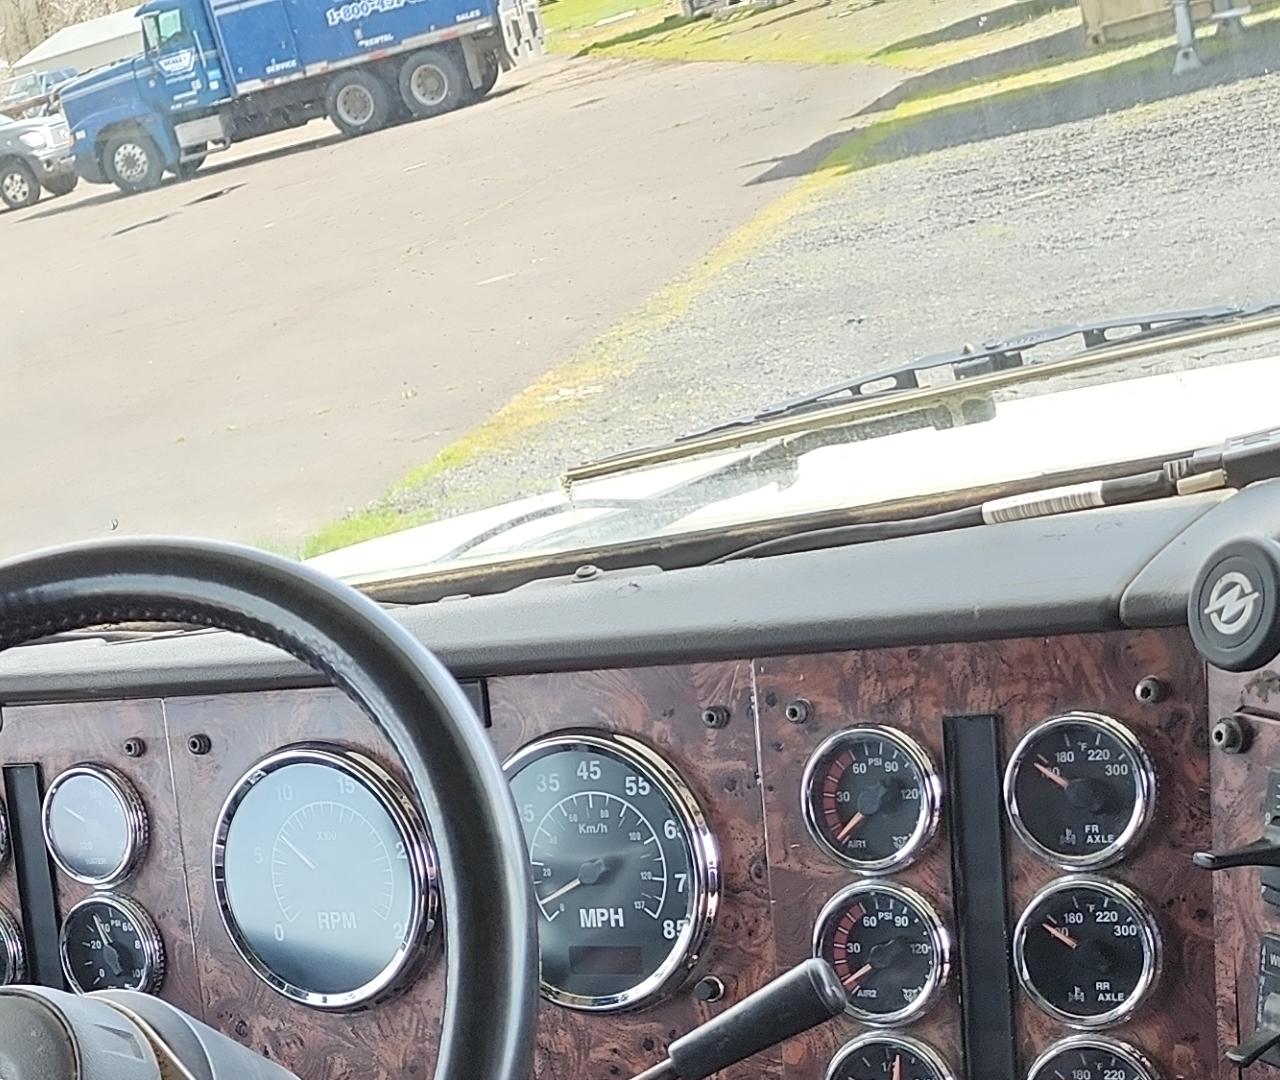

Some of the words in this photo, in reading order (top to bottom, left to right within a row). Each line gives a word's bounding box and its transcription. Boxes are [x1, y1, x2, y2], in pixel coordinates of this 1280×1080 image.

[265, 58, 297, 75] SERVICE
[1057, 751, 1074, 762] 180
[1088, 749, 1110, 761] 220
[576, 760, 602, 780] 45
[853, 763, 867, 774] 60
[868, 757, 883, 766] PSI
[884, 761, 898, 772] 90
[1105, 764, 1128, 776] 300
[336, 776, 355, 795] 15
[536, 773, 560, 792] 35
[625, 777, 651, 796] 55
[277, 784, 293, 801] 10
[836, 791, 850, 802] 30
[902, 788, 919, 800] 120
[578, 823, 608, 834] Km/h
[1084, 824, 1099, 833] FR
[628, 832, 641, 841] 100
[1086, 834, 1114, 843] AXLE
[253, 847, 263, 864] 5
[542, 867, 551, 877] 20
[640, 871, 652, 880] 120
[317, 912, 357, 929] RPM
[579, 908, 624, 928] MPH
[863, 916, 877, 927] 60
[878, 911, 893, 921] PSI
[895, 916, 908, 927] 90
[1064, 912, 1083, 924] 180
[1095, 911, 1118, 922] 220
[122, 922, 133, 931] 60
[663, 919, 689, 939] 85
[1113, 925, 1137, 936] 300
[273, 924, 284, 941] 0
[90, 940, 102, 949] 20
[847, 942, 861, 953] 30
[911, 943, 928, 954] 120
[99, 968, 105, 978] 0
[1095, 982, 1110, 990] RR
[1098, 993, 1125, 1001] AXLE
[1072, 1070, 1091, 1080] 180
[1104, 1070, 1126, 1080] 220
